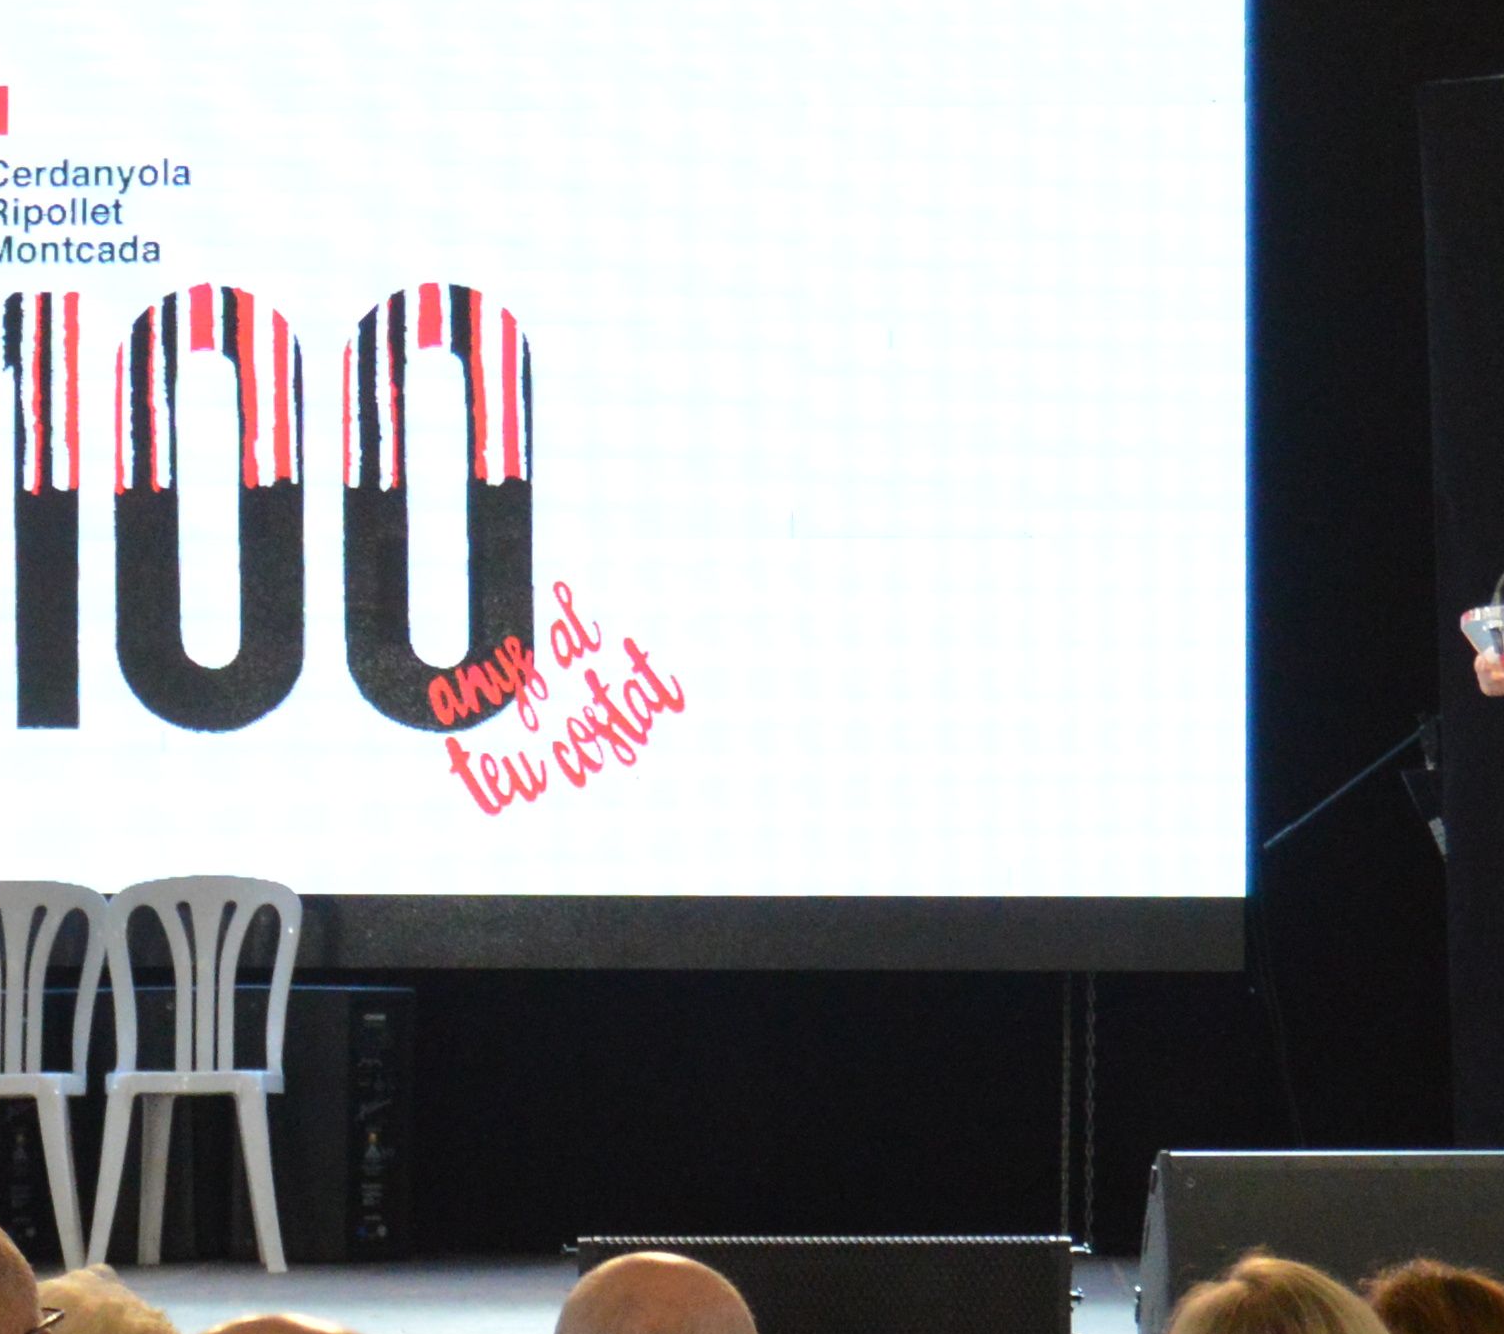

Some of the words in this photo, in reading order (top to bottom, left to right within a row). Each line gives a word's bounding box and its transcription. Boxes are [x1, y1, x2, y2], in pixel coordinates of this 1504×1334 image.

[428, 635, 549, 732] anys
[550, 581, 601, 669] al
[445, 736, 548, 816] teu
[552, 637, 686, 788] costat
